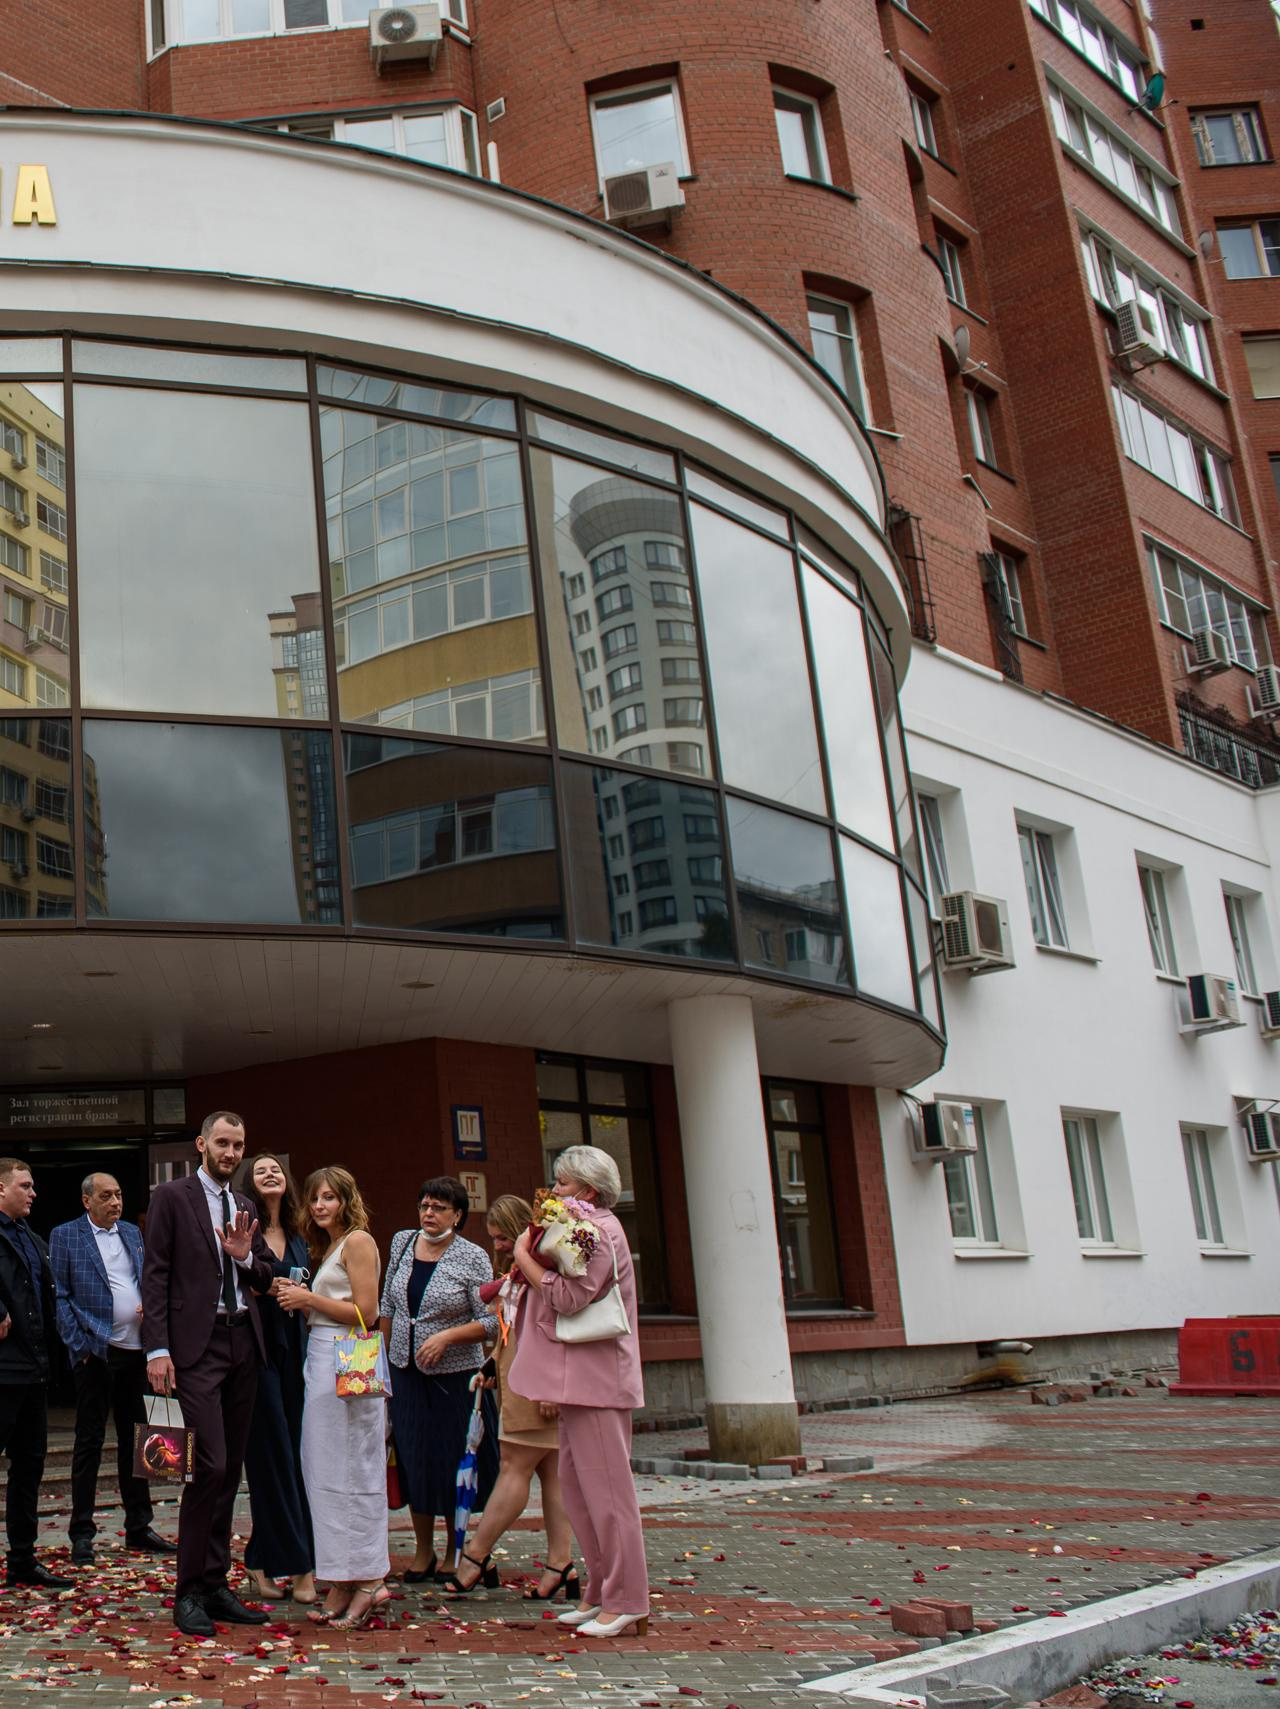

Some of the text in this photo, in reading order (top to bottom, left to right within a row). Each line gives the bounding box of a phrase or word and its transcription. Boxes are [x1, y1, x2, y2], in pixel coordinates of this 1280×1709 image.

[9, 1095, 119, 1109] Зал торжественной
[85, 1110, 118, 1123] брака
